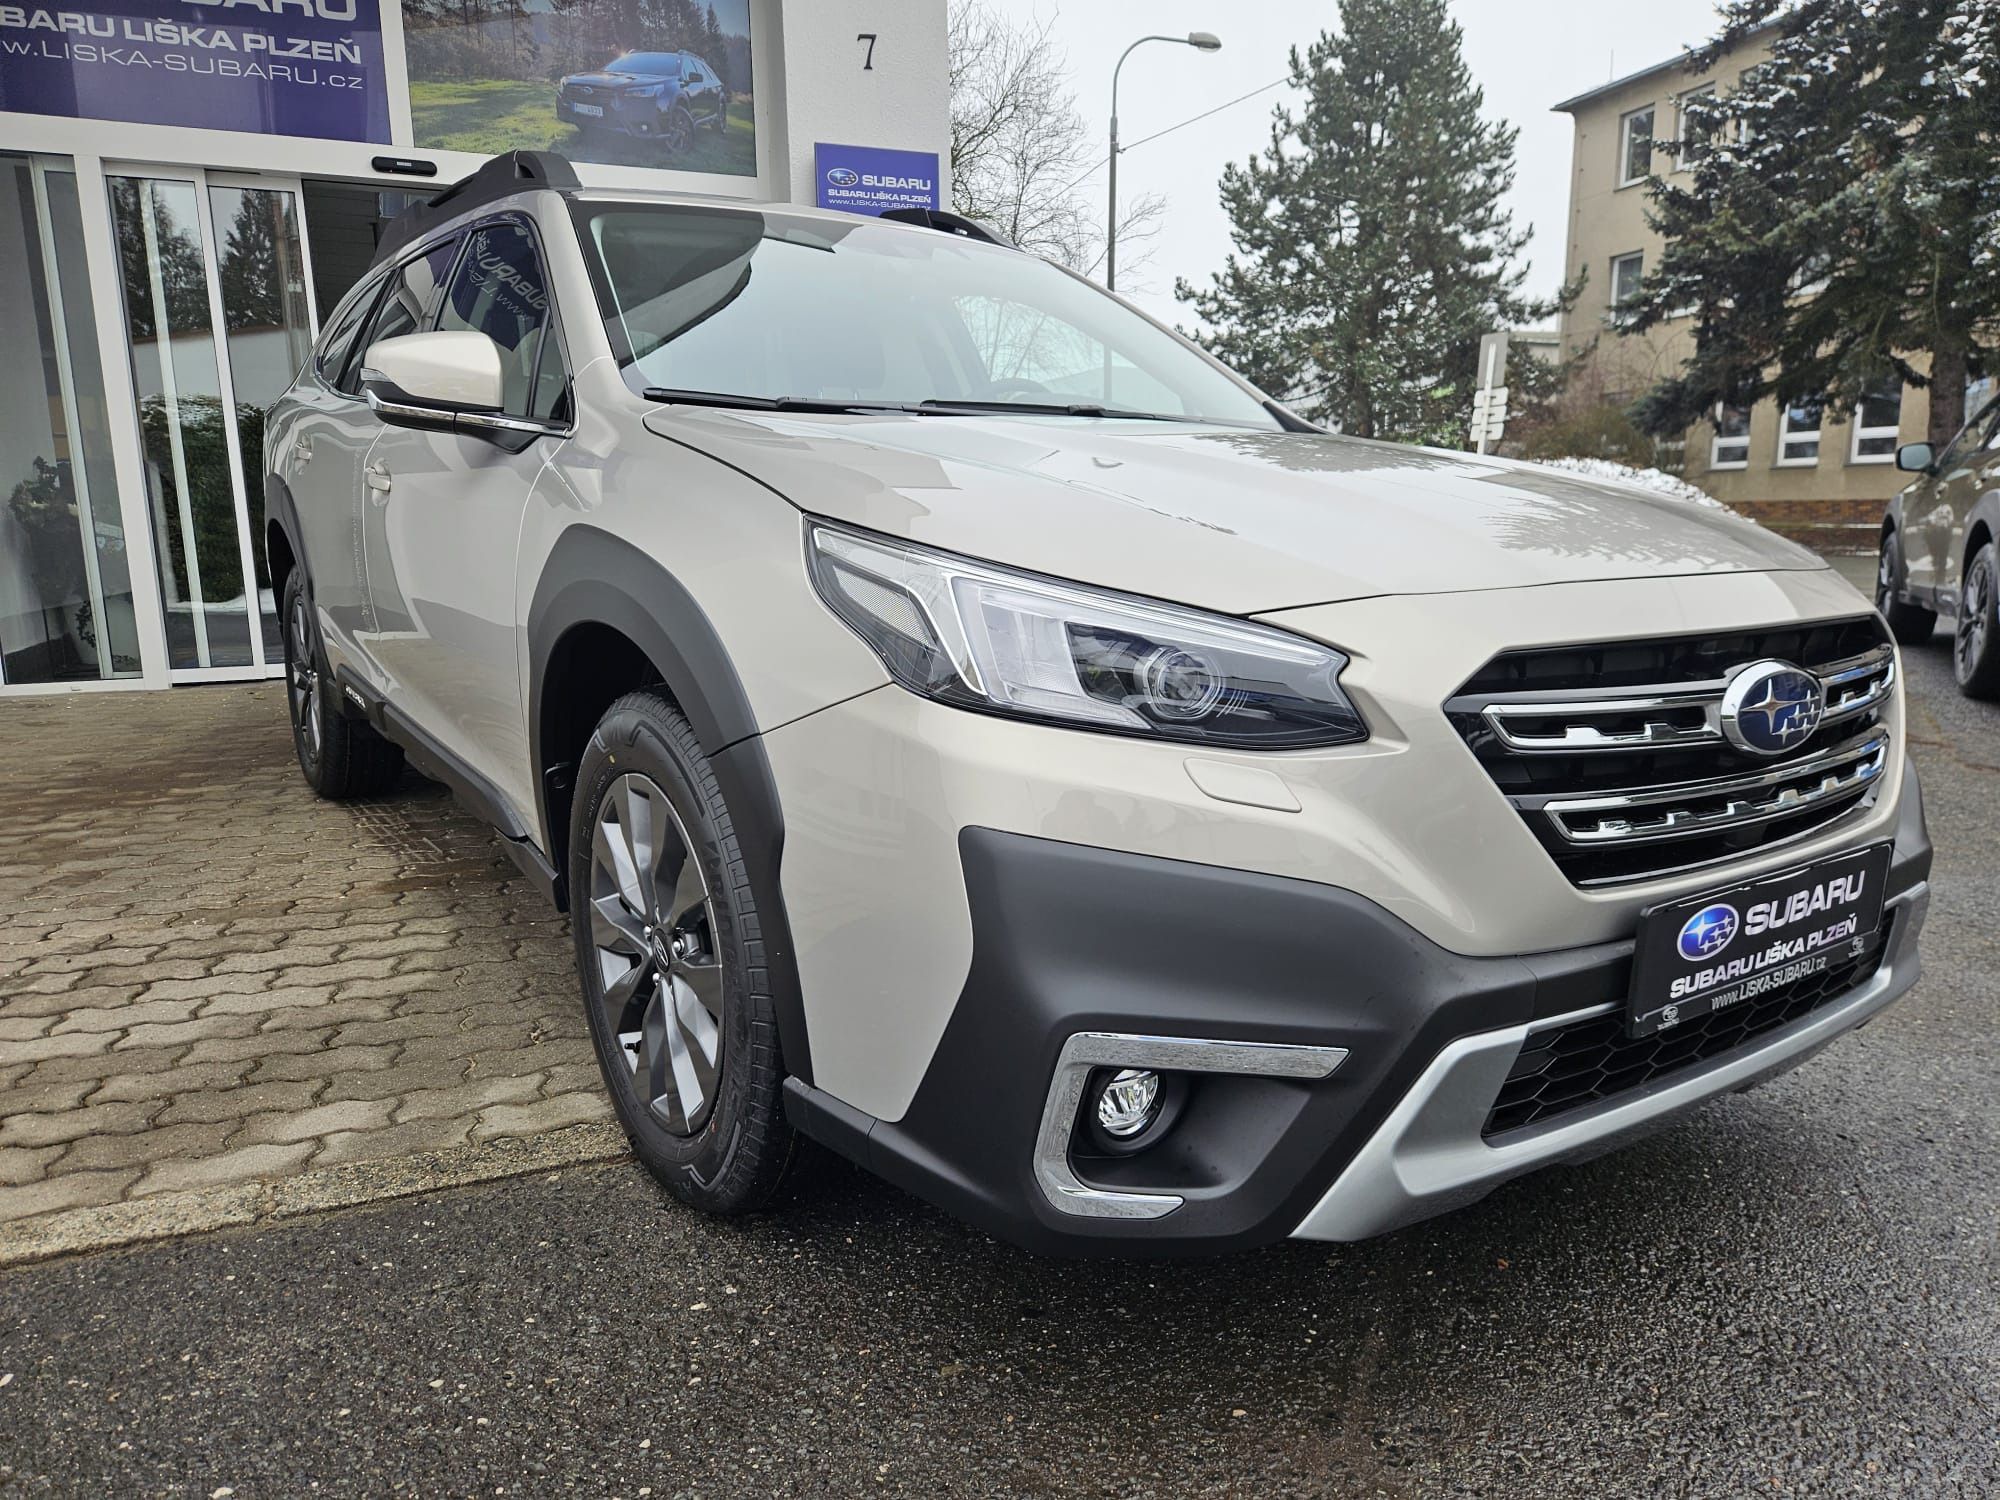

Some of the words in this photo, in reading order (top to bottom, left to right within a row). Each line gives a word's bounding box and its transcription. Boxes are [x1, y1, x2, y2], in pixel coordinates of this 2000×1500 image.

[123, 18, 238, 50] LIŠKA
[244, 33, 362, 65] PLZEŇ
[857, 34, 877, 70] 7
[828, 188, 870, 199] SUBARU
[871, 191, 899, 201] LIŠKA
[900, 194, 932, 204] PLZEŇ
[862, 174, 931, 191] SUBARU
[1744, 870, 1866, 936] SUBARU
[1669, 954, 1755, 999] SUBARU
[1754, 940, 1806, 970] LIŠKA
[1806, 912, 1858, 952] PLZEŇ
[1711, 956, 1828, 1011] www.LISKA-SUBARU.cz
